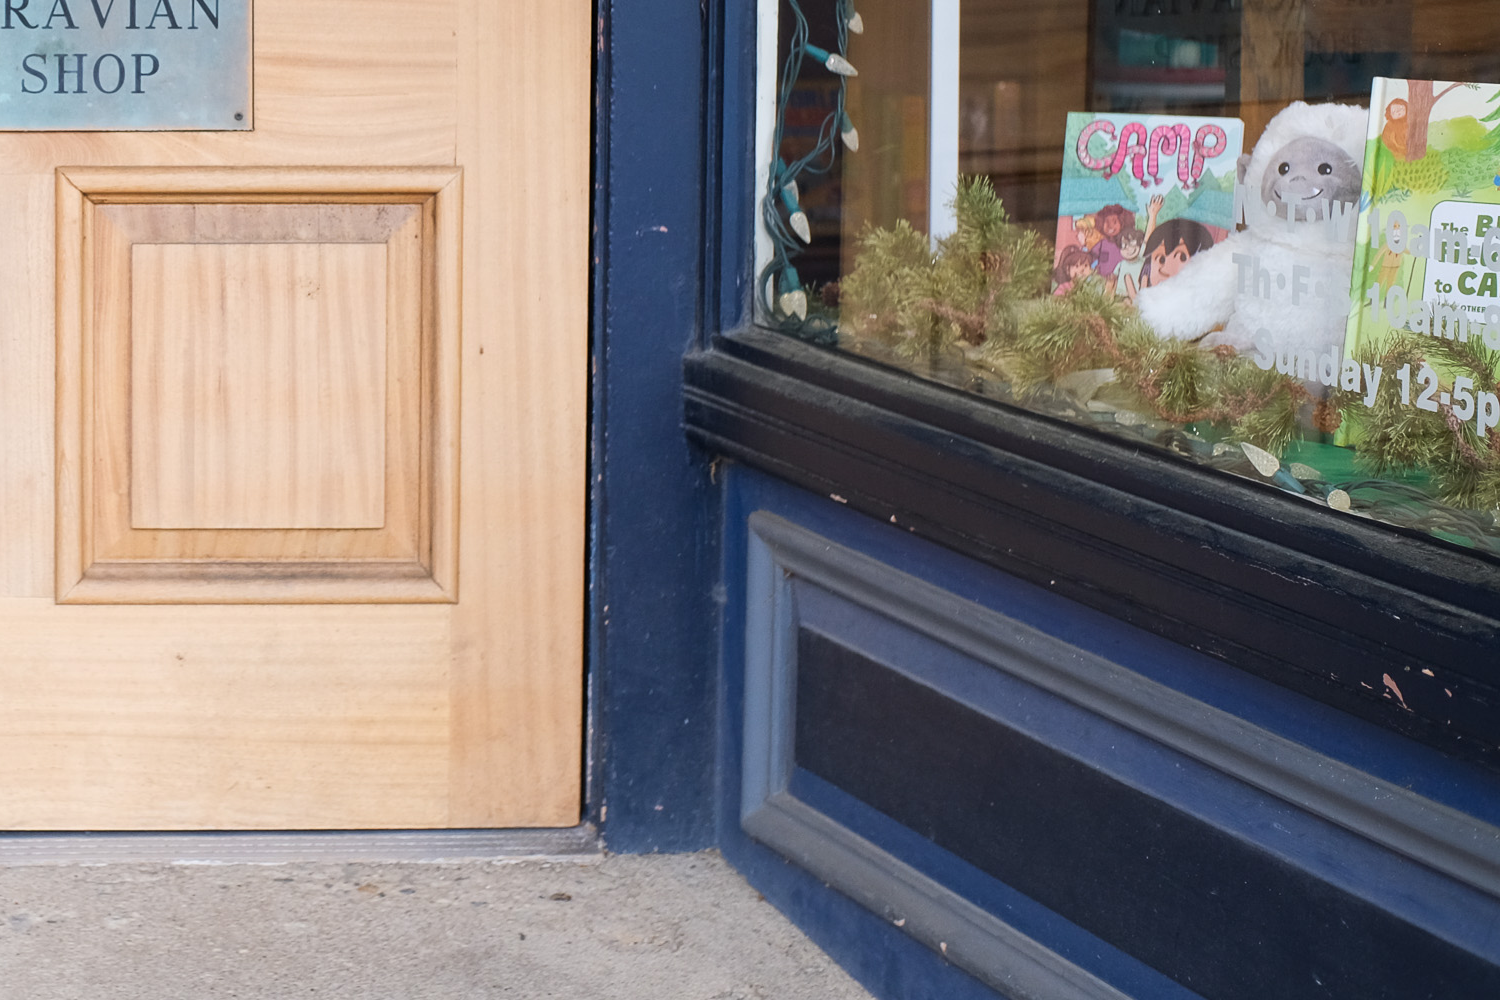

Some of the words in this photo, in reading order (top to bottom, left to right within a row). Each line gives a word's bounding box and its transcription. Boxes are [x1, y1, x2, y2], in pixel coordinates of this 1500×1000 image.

[21, 52, 160, 94] SHOP
[1077, 119, 1228, 189] CAMP
[1434, 279, 1453, 293] to
[1253, 327, 1383, 409] Sunday
